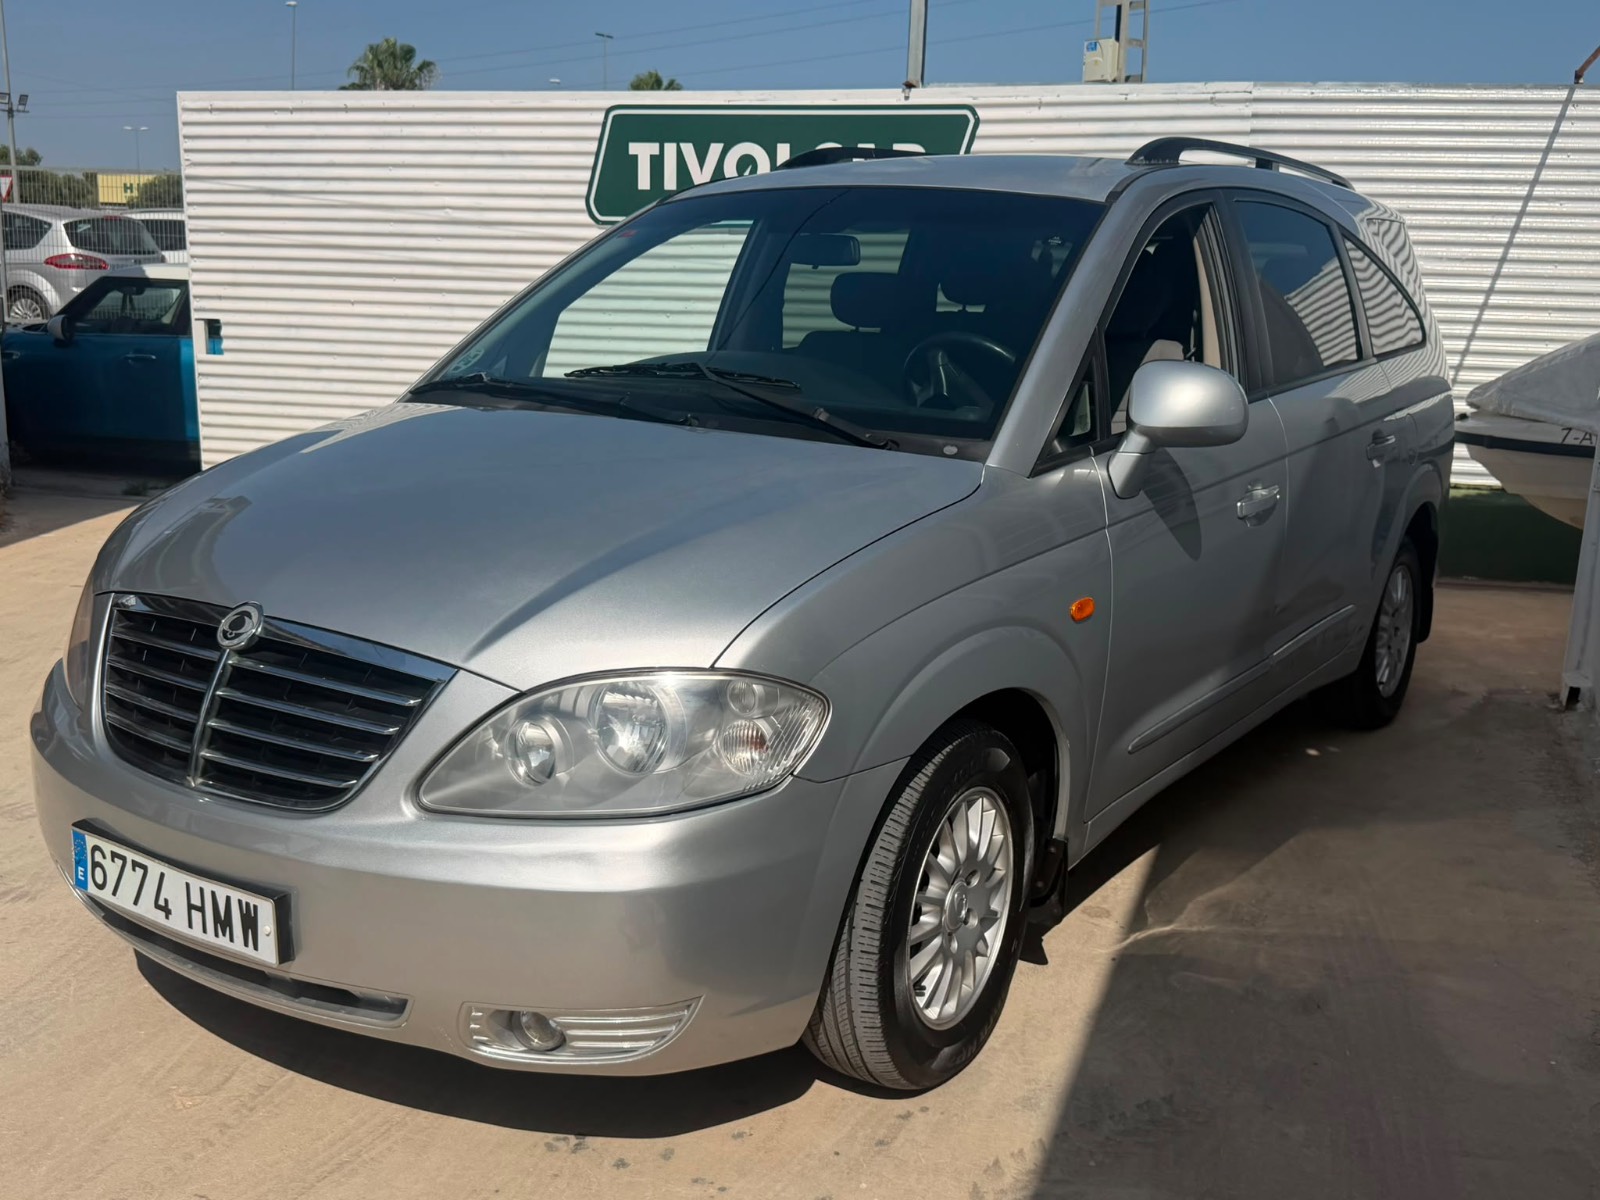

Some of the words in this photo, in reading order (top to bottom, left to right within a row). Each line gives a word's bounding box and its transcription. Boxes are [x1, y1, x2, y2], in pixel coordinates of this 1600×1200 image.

[628, 142, 926, 191] TIVO
[78, 866, 85, 880] E
[90, 844, 172, 920] 6774
[185, 881, 259, 951] HMW
